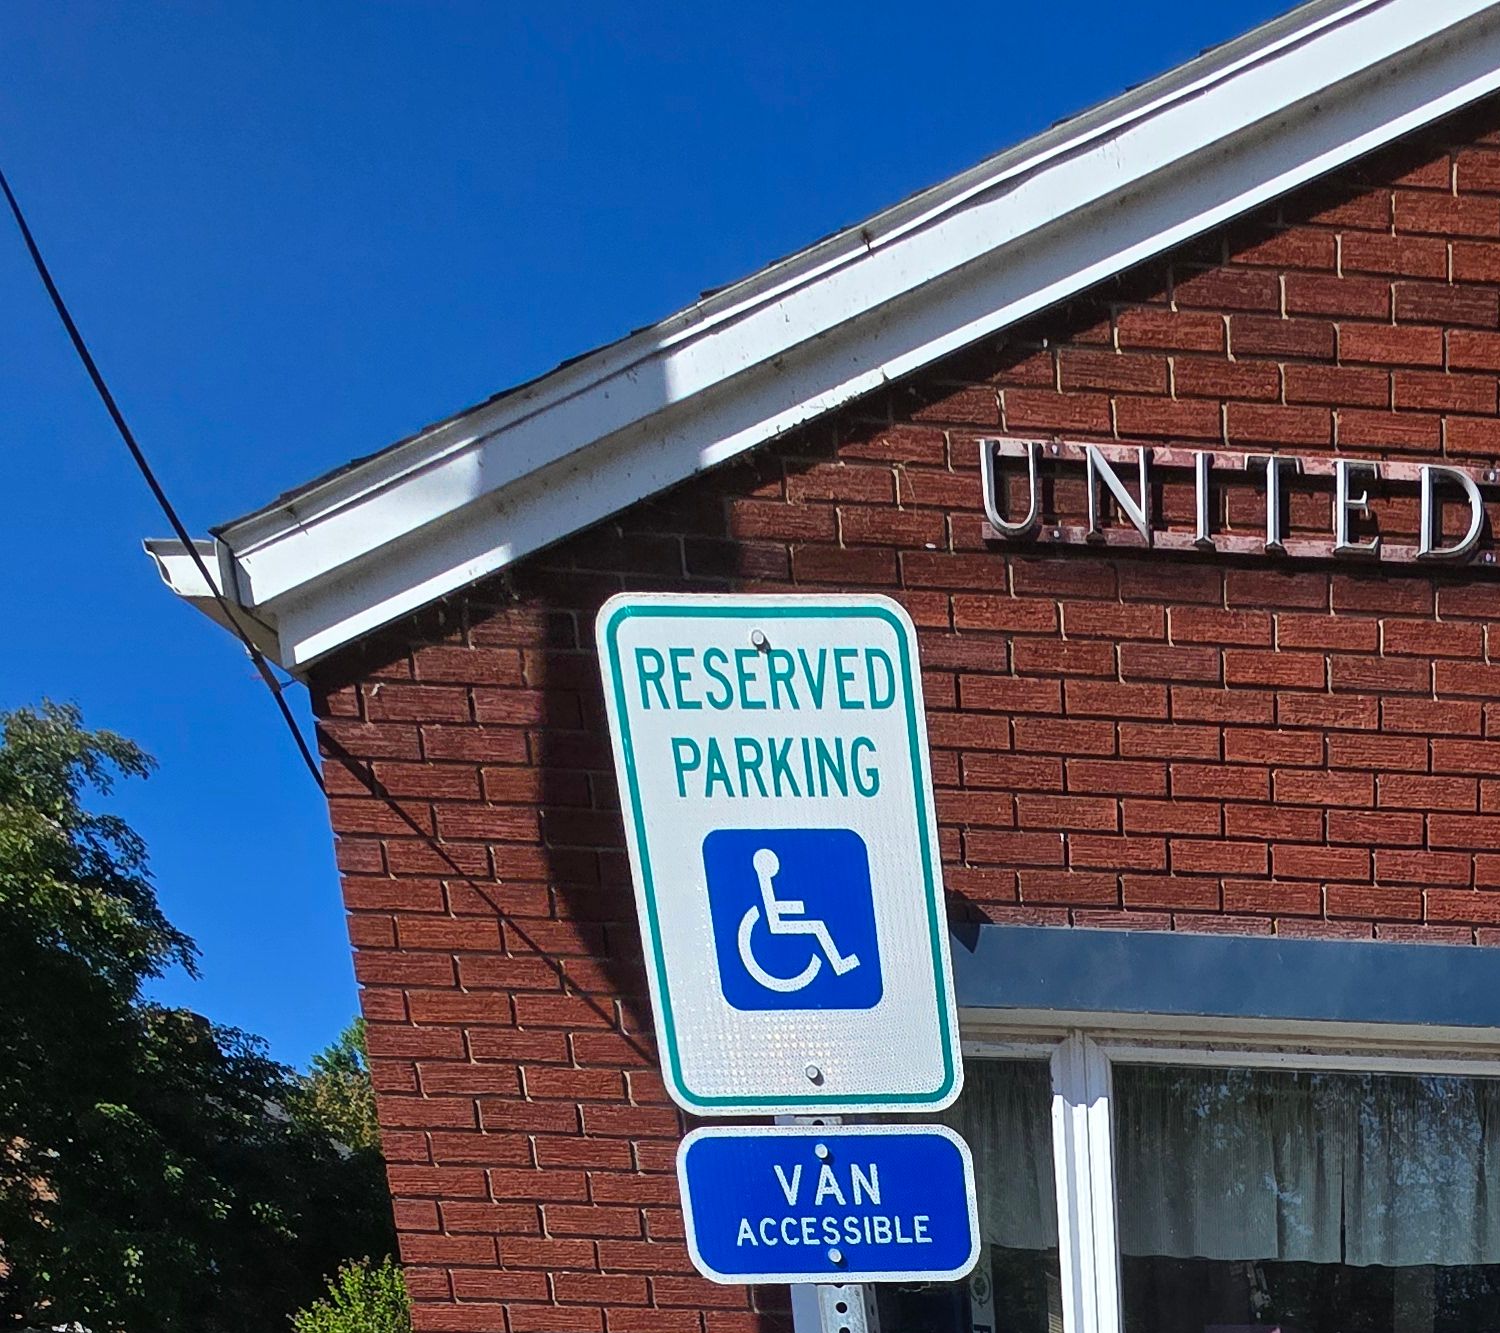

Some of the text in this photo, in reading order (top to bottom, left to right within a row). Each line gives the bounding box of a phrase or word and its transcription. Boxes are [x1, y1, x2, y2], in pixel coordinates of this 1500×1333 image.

[978, 438, 1485, 560] UNITED
[634, 647, 897, 711] RESERVED
[671, 736, 882, 798] PARKING
[773, 1163, 883, 1206] VAN
[735, 1215, 933, 1247] ACCESSIBLE
